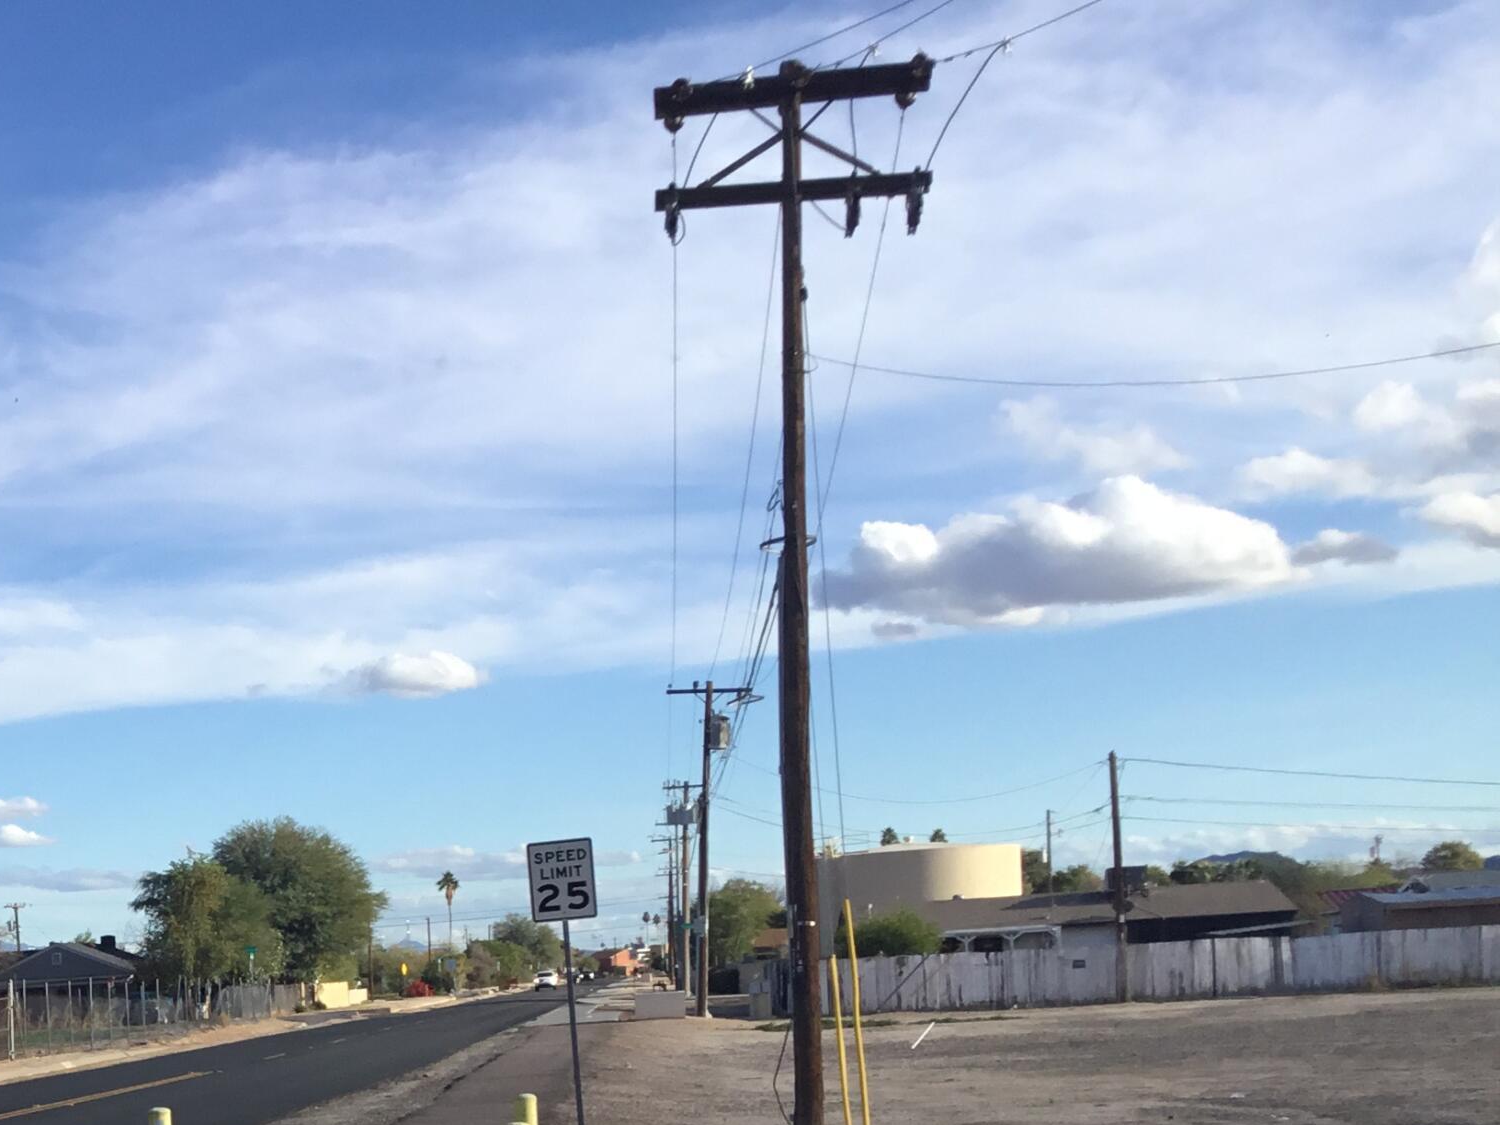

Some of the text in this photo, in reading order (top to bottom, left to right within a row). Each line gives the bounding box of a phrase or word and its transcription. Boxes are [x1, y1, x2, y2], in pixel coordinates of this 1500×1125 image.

[534, 848, 587, 865] SPEED
[540, 865, 582, 880] LIMIT
[537, 881, 589, 912] 25
